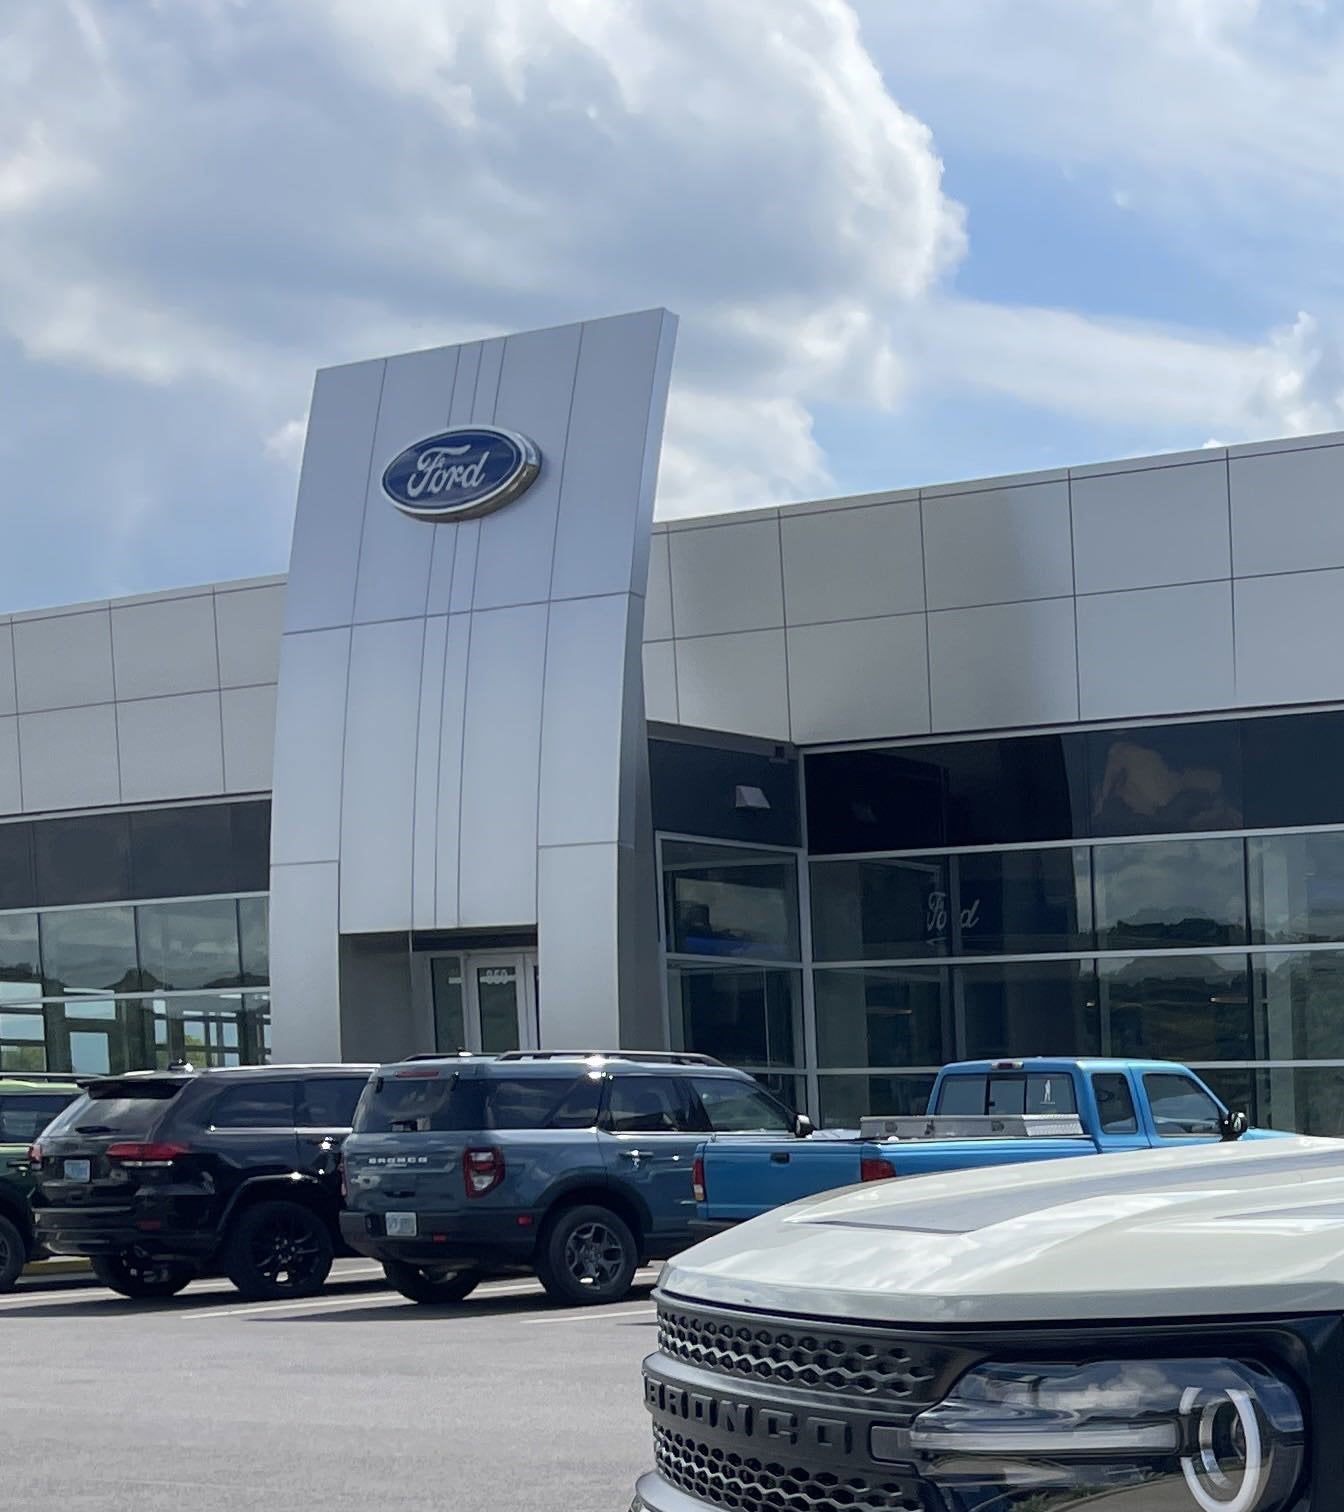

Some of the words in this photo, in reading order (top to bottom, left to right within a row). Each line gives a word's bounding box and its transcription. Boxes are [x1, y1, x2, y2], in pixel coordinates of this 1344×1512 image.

[407, 444, 490, 497] Ford
[927, 891, 980, 931] Fod
[646, 1378, 850, 1453] BRONCO
